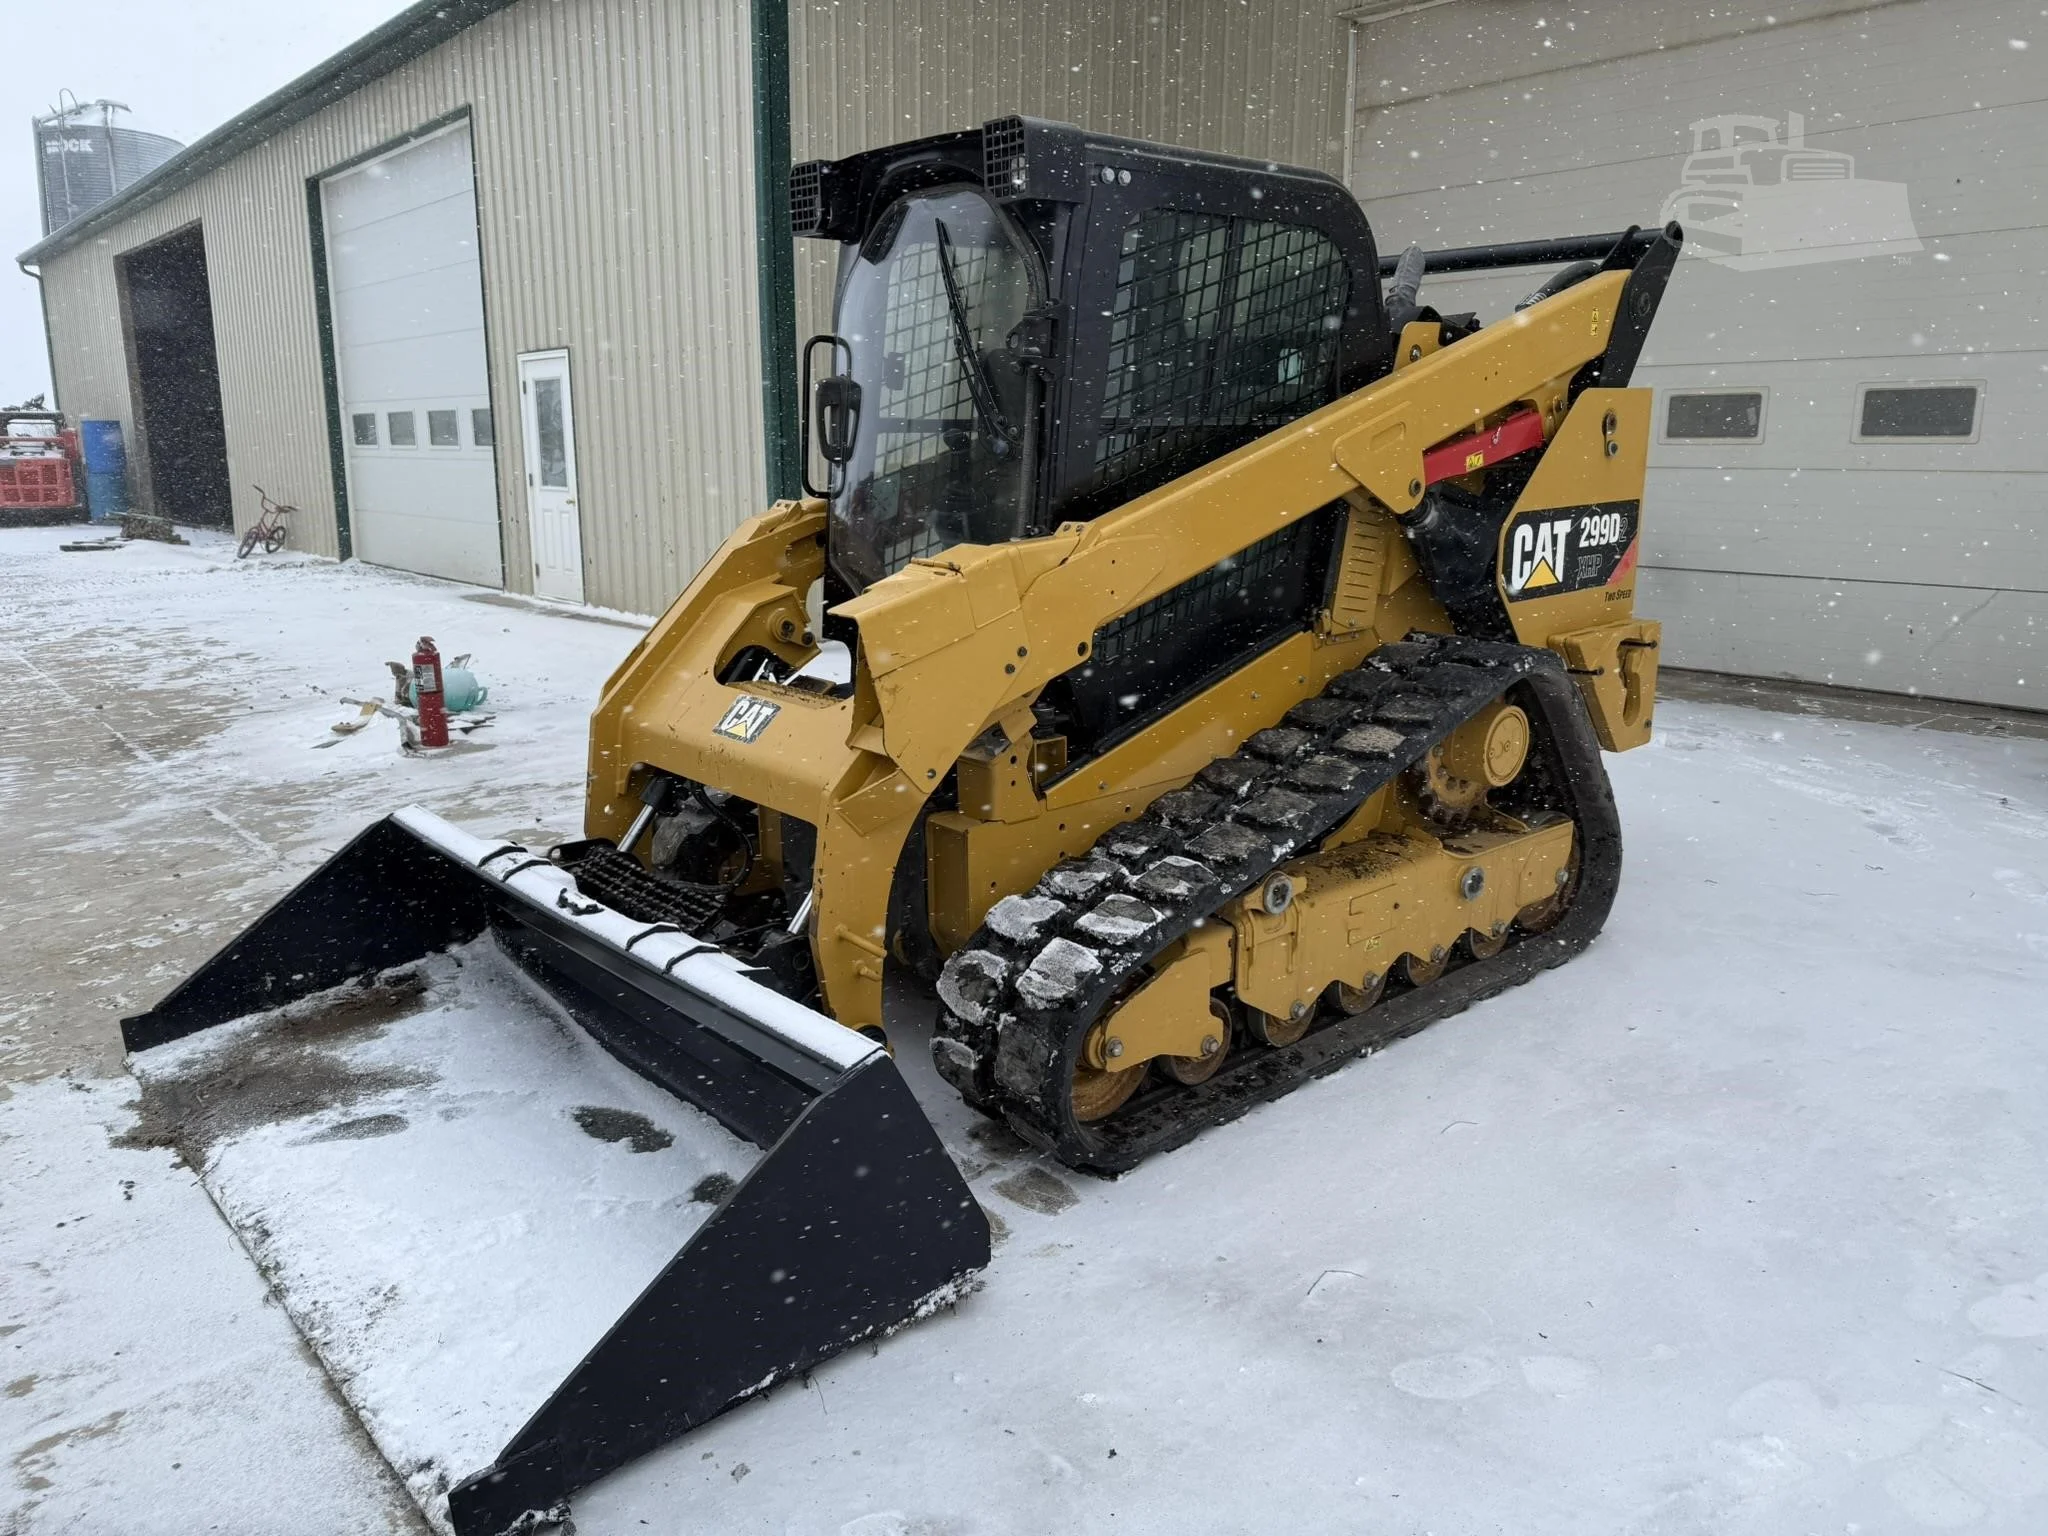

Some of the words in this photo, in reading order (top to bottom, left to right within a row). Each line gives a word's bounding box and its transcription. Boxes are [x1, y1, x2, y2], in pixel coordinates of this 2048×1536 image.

[1511, 519, 1572, 590] CAT
[1577, 553, 1602, 579] XHP
[720, 699, 777, 739] CAT
